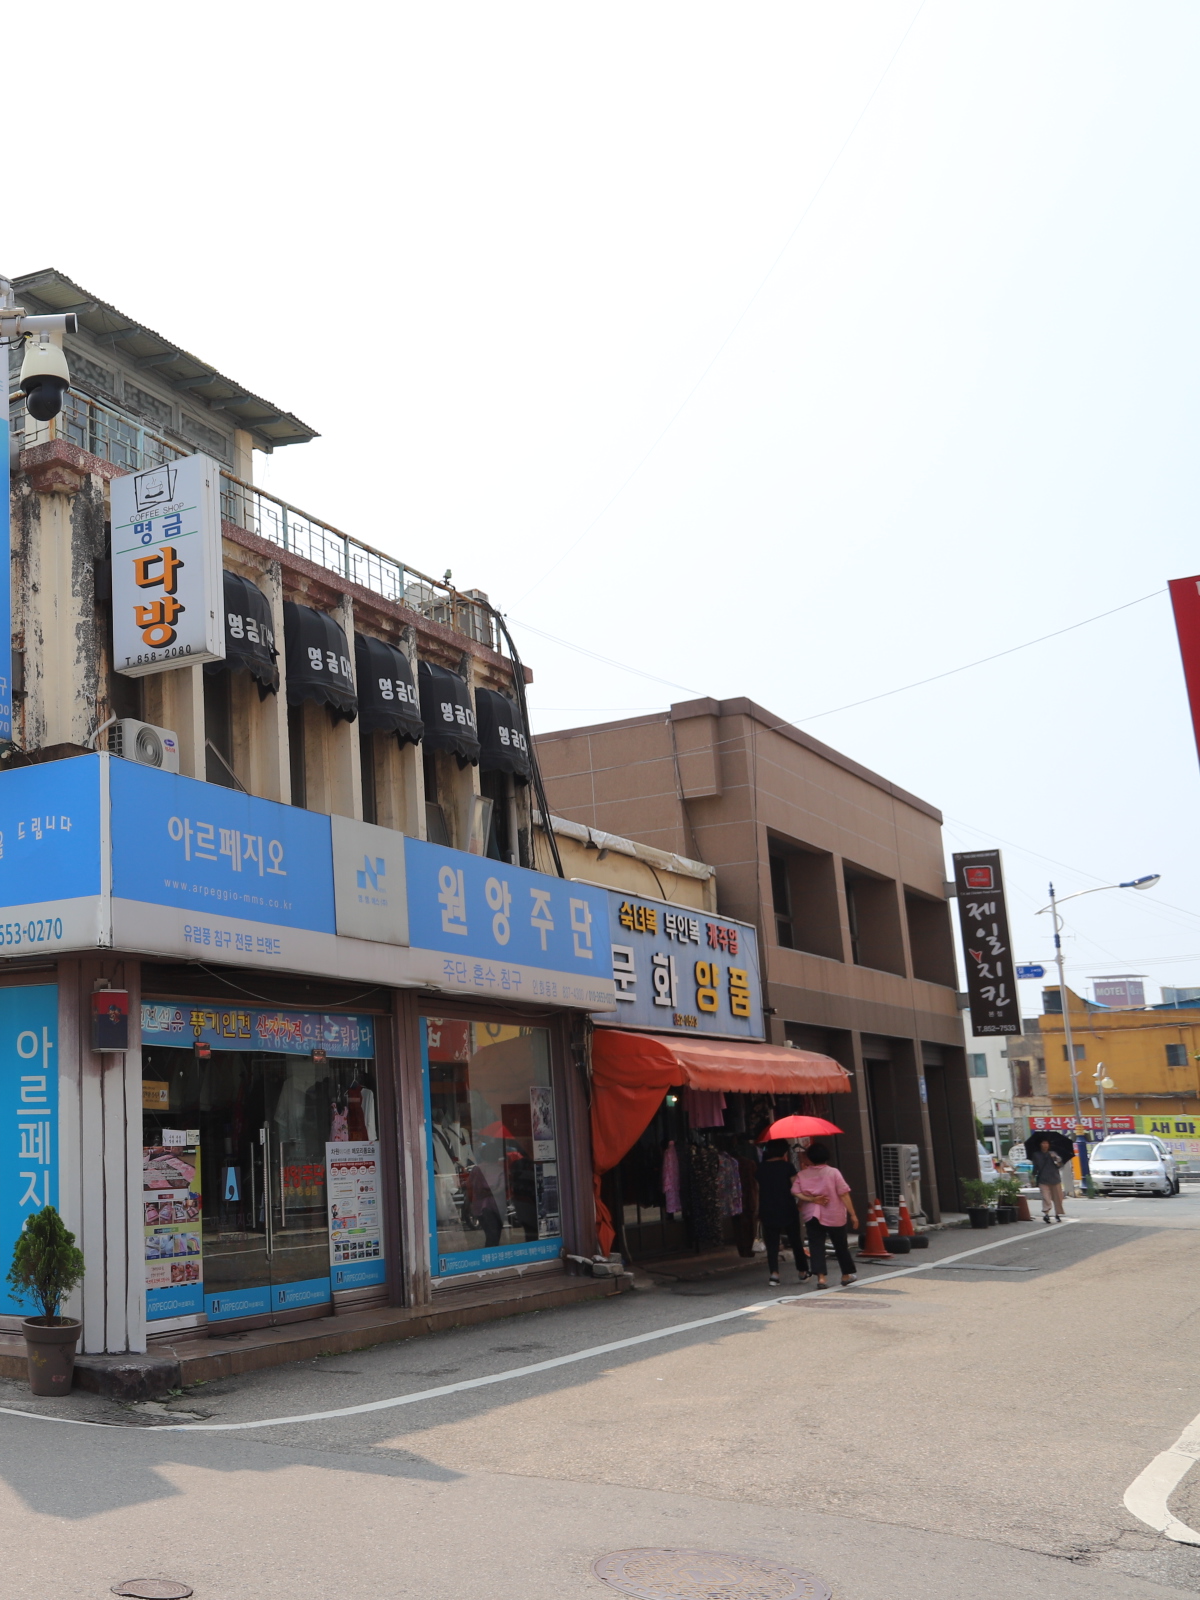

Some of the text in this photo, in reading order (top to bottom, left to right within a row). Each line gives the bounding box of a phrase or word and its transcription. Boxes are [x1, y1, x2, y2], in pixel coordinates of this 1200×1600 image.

[130, 502, 184, 524] COFFEE SHOP
[134, 513, 182, 545] 명금
[132, 546, 186, 649] 다방
[125, 644, 192, 667] T.858-2080
[498, 726, 529, 758] 명금다
[17, 815, 72, 841] 드립니다
[168, 816, 287, 876] 아르페지오
[164, 878, 292, 911] www.arpeggio-mms.co.kr
[438, 864, 594, 960] 원양주단
[619, 901, 739, 955] 숙녀복 부인복 캐주얼
[184, 925, 282, 956] 유럽풍 침구 전문 브랜드
[611, 944, 751, 1018] 문화 양품
[1096, 987, 1126, 996] MOTEL
[189, 1010, 252, 1039] 풍기인견
[256, 1014, 325, 1043] 산지가격으로
[16, 1026, 54, 1231] 아르페지
[1032, 1117, 1094, 1130] 동신상회
[148, 1300, 178, 1312] ARPEGGIO
[220, 1300, 248, 1312] ARPEGGIO
